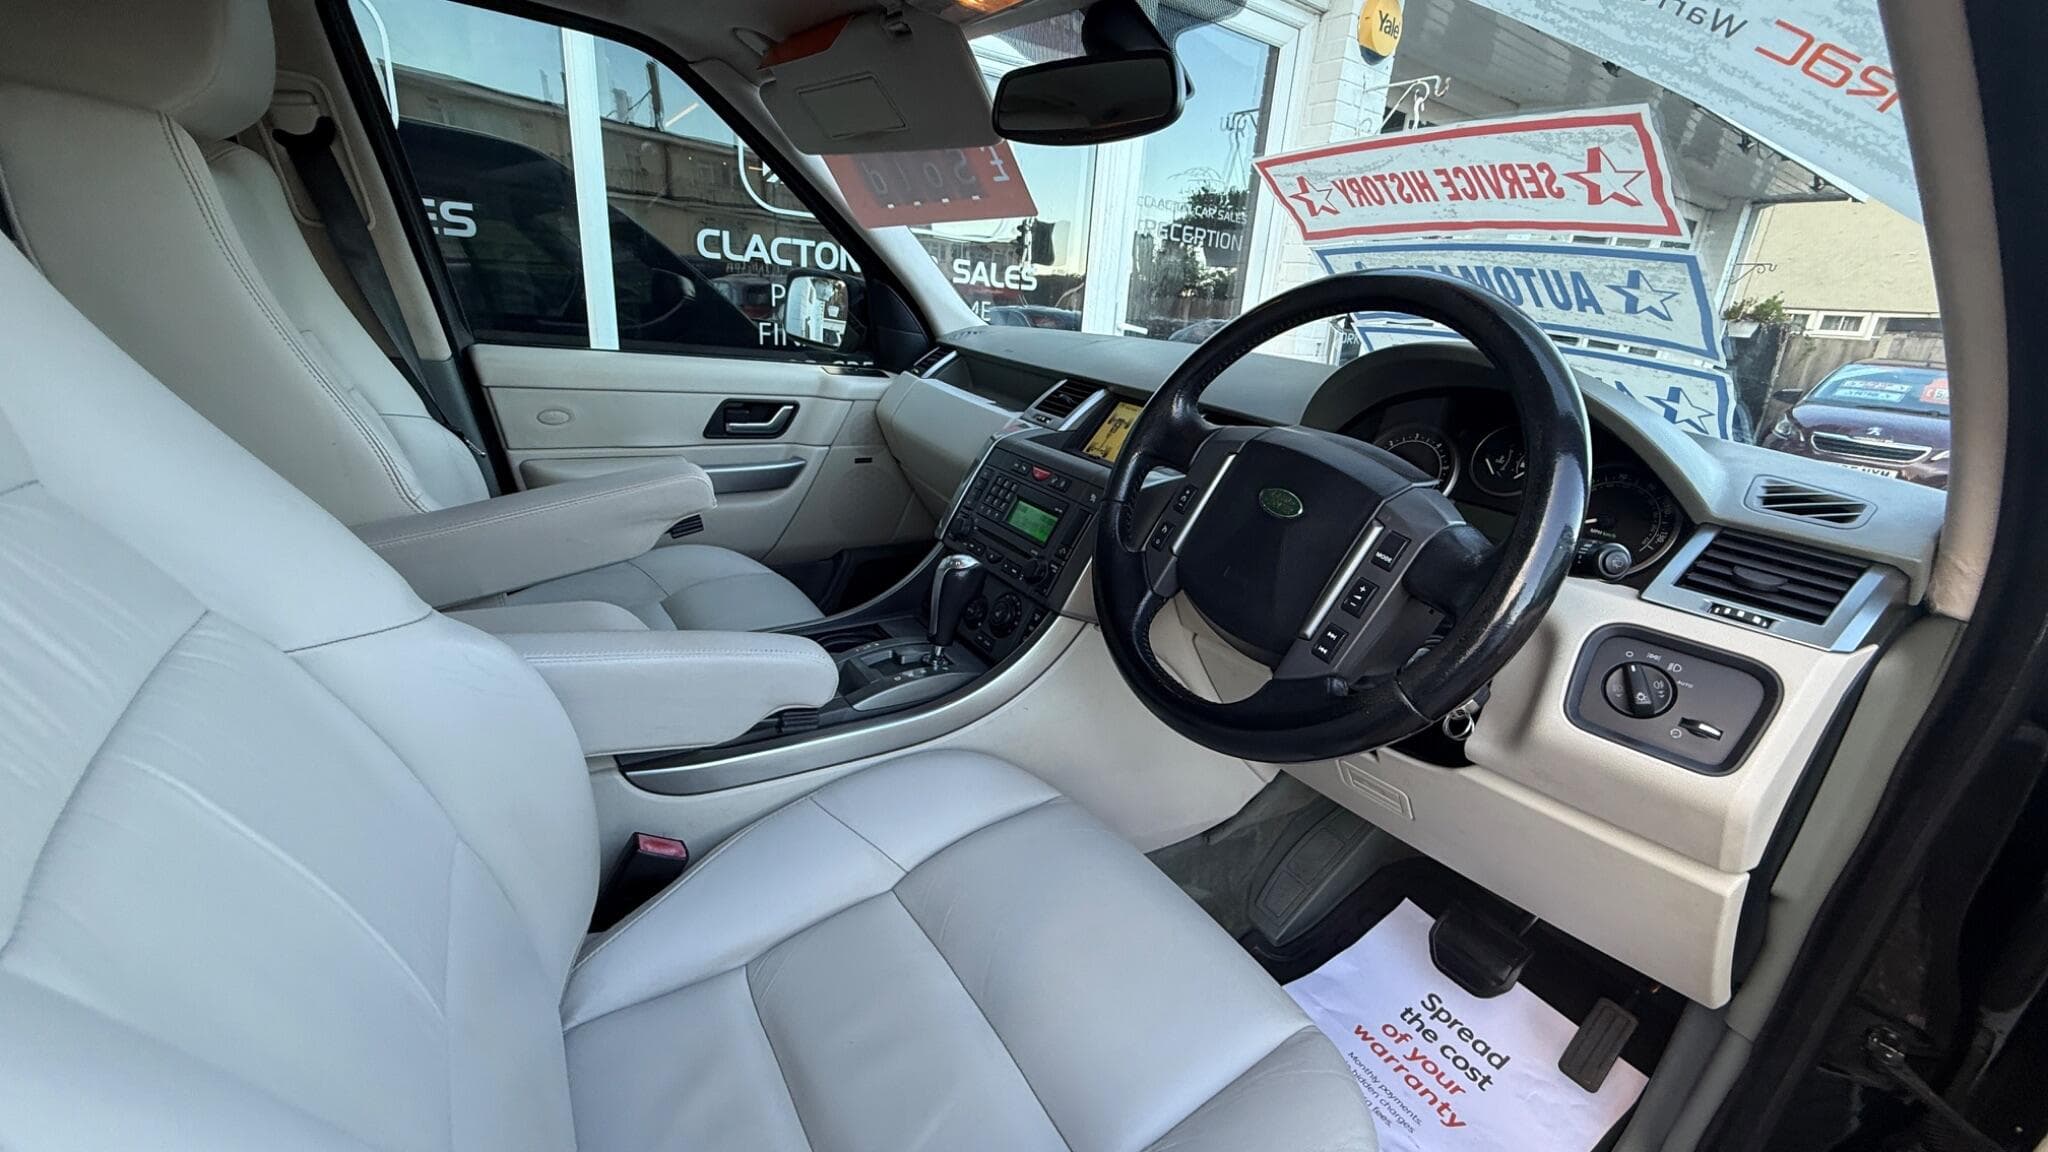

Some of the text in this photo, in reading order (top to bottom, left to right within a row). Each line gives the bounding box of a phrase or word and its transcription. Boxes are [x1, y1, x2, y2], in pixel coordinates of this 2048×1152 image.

[1379, 9, 1400, 40] Yale
[1195, 205, 1217, 220] CAR
[1217, 209, 1248, 225] SALES
[1138, 219, 1244, 252] RECEPTION
[952, 258, 1039, 292] SALES
[1420, 992, 1511, 1071] Spread
[1381, 1023, 1467, 1095] of your
[1400, 1006, 1494, 1092] the cost
[1347, 1051, 1381, 1084] Monthly
[1351, 1069, 1380, 1099] hidden
[1354, 1024, 1467, 1128] warranty
